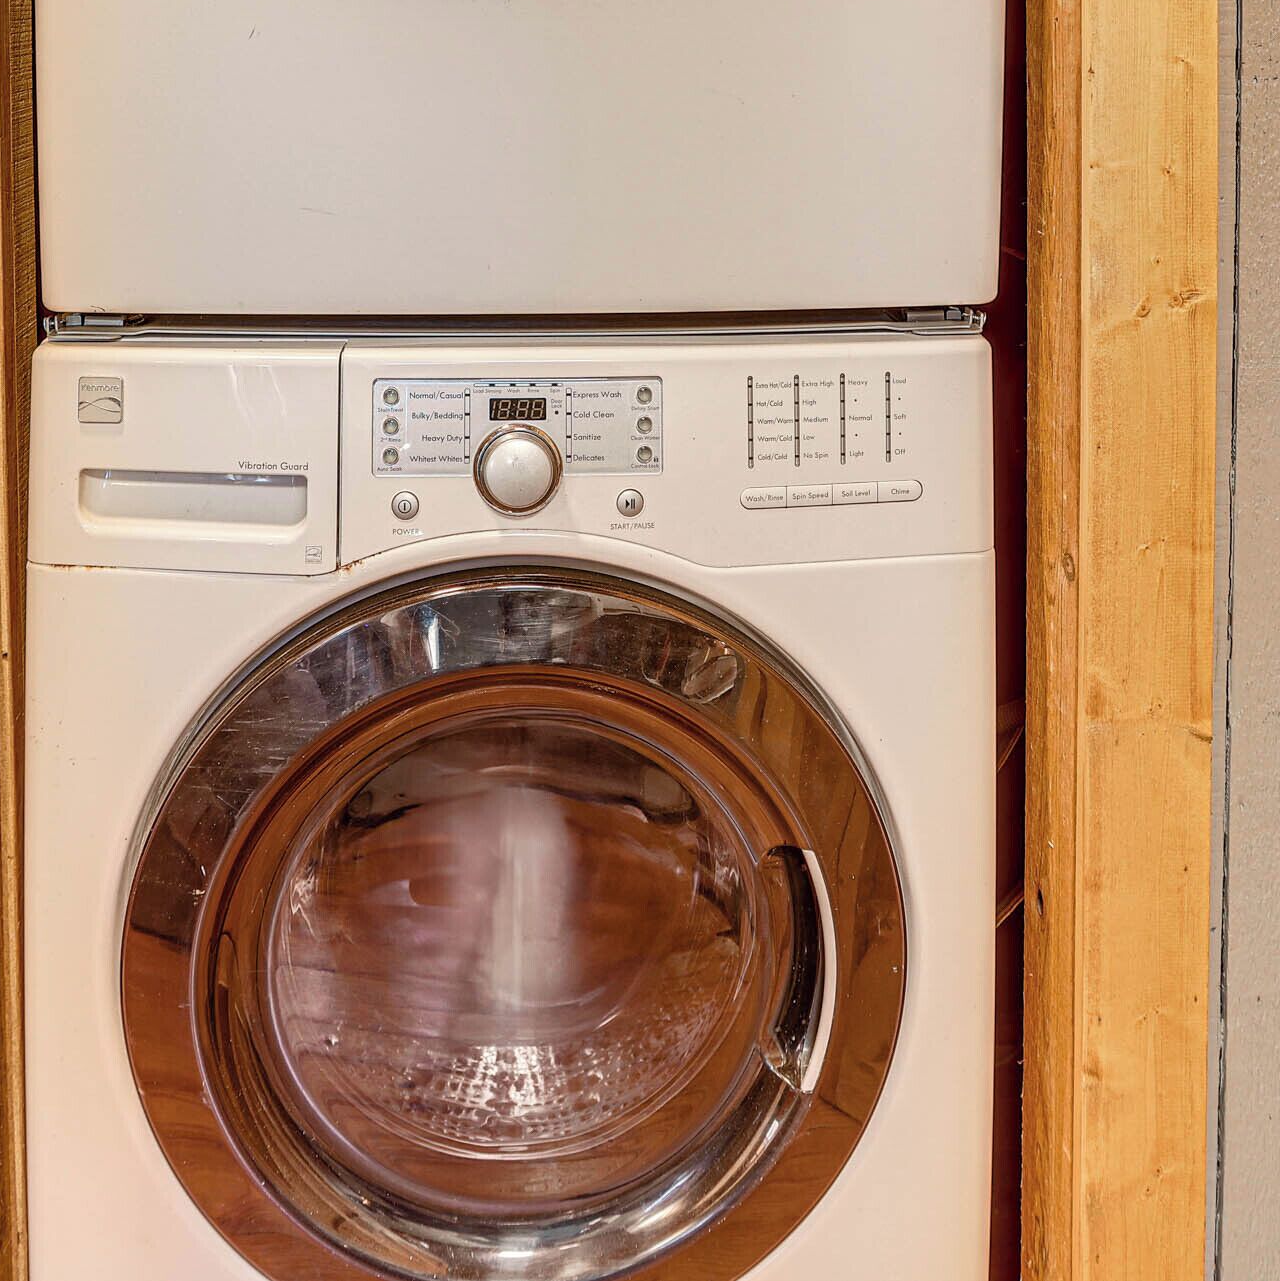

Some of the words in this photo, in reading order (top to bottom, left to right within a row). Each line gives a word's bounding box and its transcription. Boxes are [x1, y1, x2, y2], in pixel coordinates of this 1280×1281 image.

[801, 380, 818, 388] Extra
[820, 380, 835, 389] High
[847, 379, 868, 387] Heavy
[892, 377, 907, 385] Loud
[81, 383, 120, 391] Kenmore
[409, 391, 464, 400] Normal/Casual
[572, 391, 599, 400] Express
[756, 400, 783, 408] Hot/Cold
[411, 411, 464, 422] Bulky/Bedding
[573, 411, 591, 419] Cold
[592, 411, 615, 419] Clean
[848, 414, 873, 422] Normal
[757, 417, 794, 425] Warm/Warm
[422, 434, 445, 443] Heavy
[446, 434, 463, 445] Duty
[573, 433, 602, 441] Sanitize
[758, 434, 793, 442] Warm/Cold
[814, 451, 829, 460] Spin
[849, 450, 865, 458] Light
[894, 448, 906, 456] Off
[409, 455, 437, 463] Whitest
[438, 455, 463, 463] Whites
[573, 454, 605, 462] Delicates
[757, 453, 788, 461] Cold/Cold
[238, 460, 278, 471] Vibration
[280, 462, 309, 471] Guard
[841, 490, 853, 498] Soil
[854, 489, 871, 497] Level
[890, 487, 910, 496] Chime
[745, 494, 784, 503] Wash/Rinse
[792, 492, 807, 501] Spin
[807, 492, 829, 500] Speed
[610, 522, 655, 531] START/PAUSE
[392, 528, 420, 536] POWER
